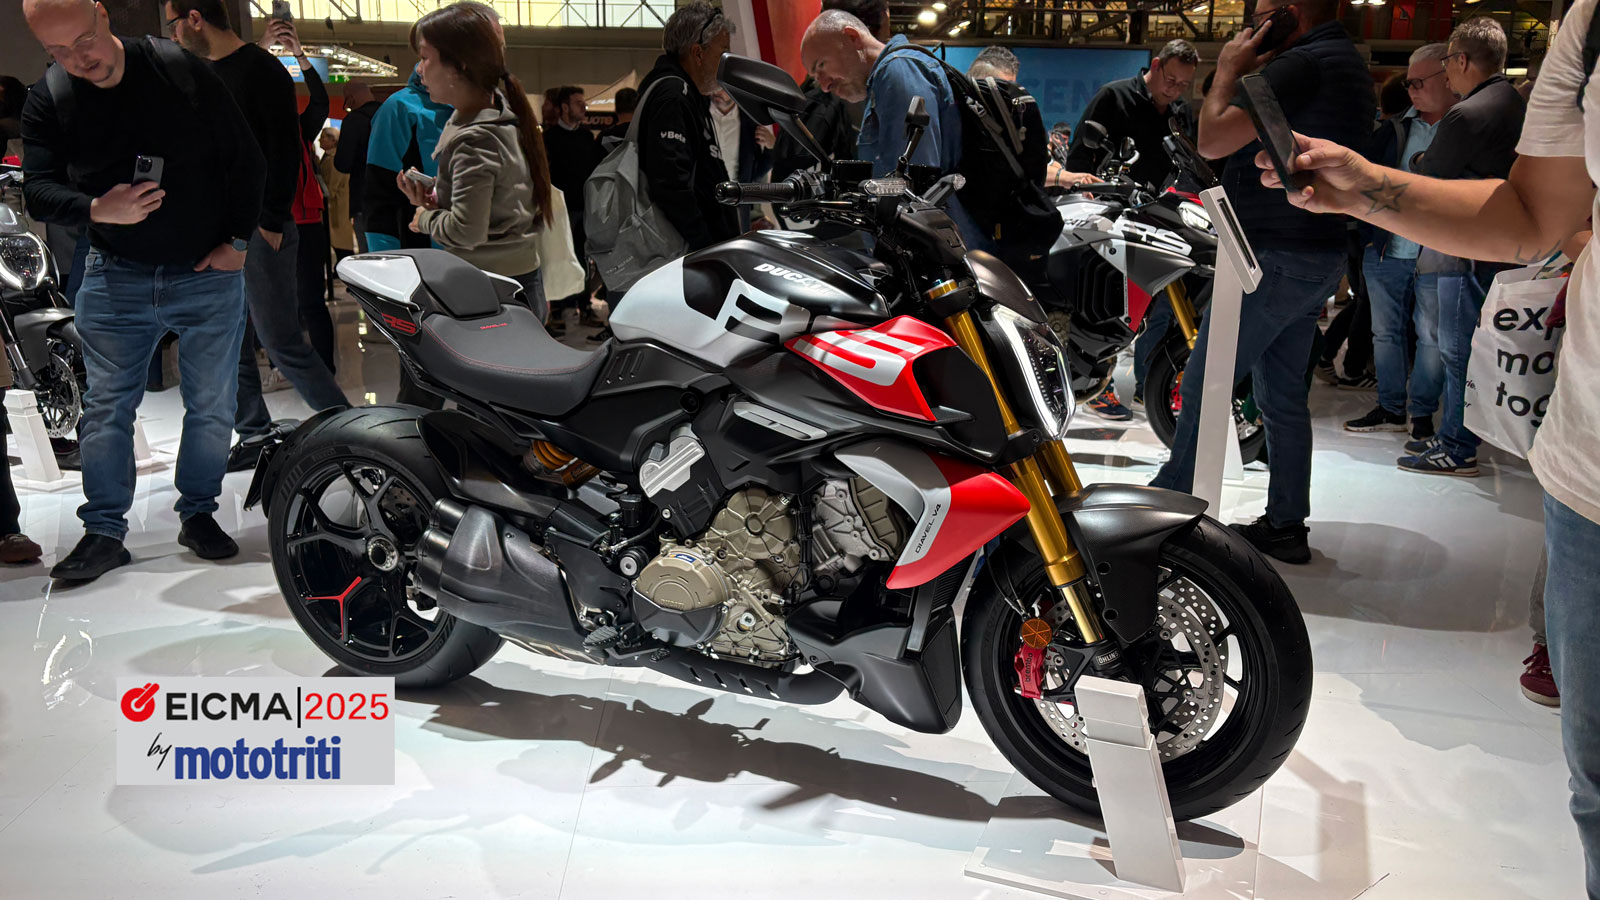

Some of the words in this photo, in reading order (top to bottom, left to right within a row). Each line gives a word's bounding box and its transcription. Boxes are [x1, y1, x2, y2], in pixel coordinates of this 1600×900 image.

[753, 263, 836, 294] DUCATI
[915, 519, 935, 553] DIAVEL
[932, 503, 942, 517] V4
[1025, 652, 1033, 682] brembo
